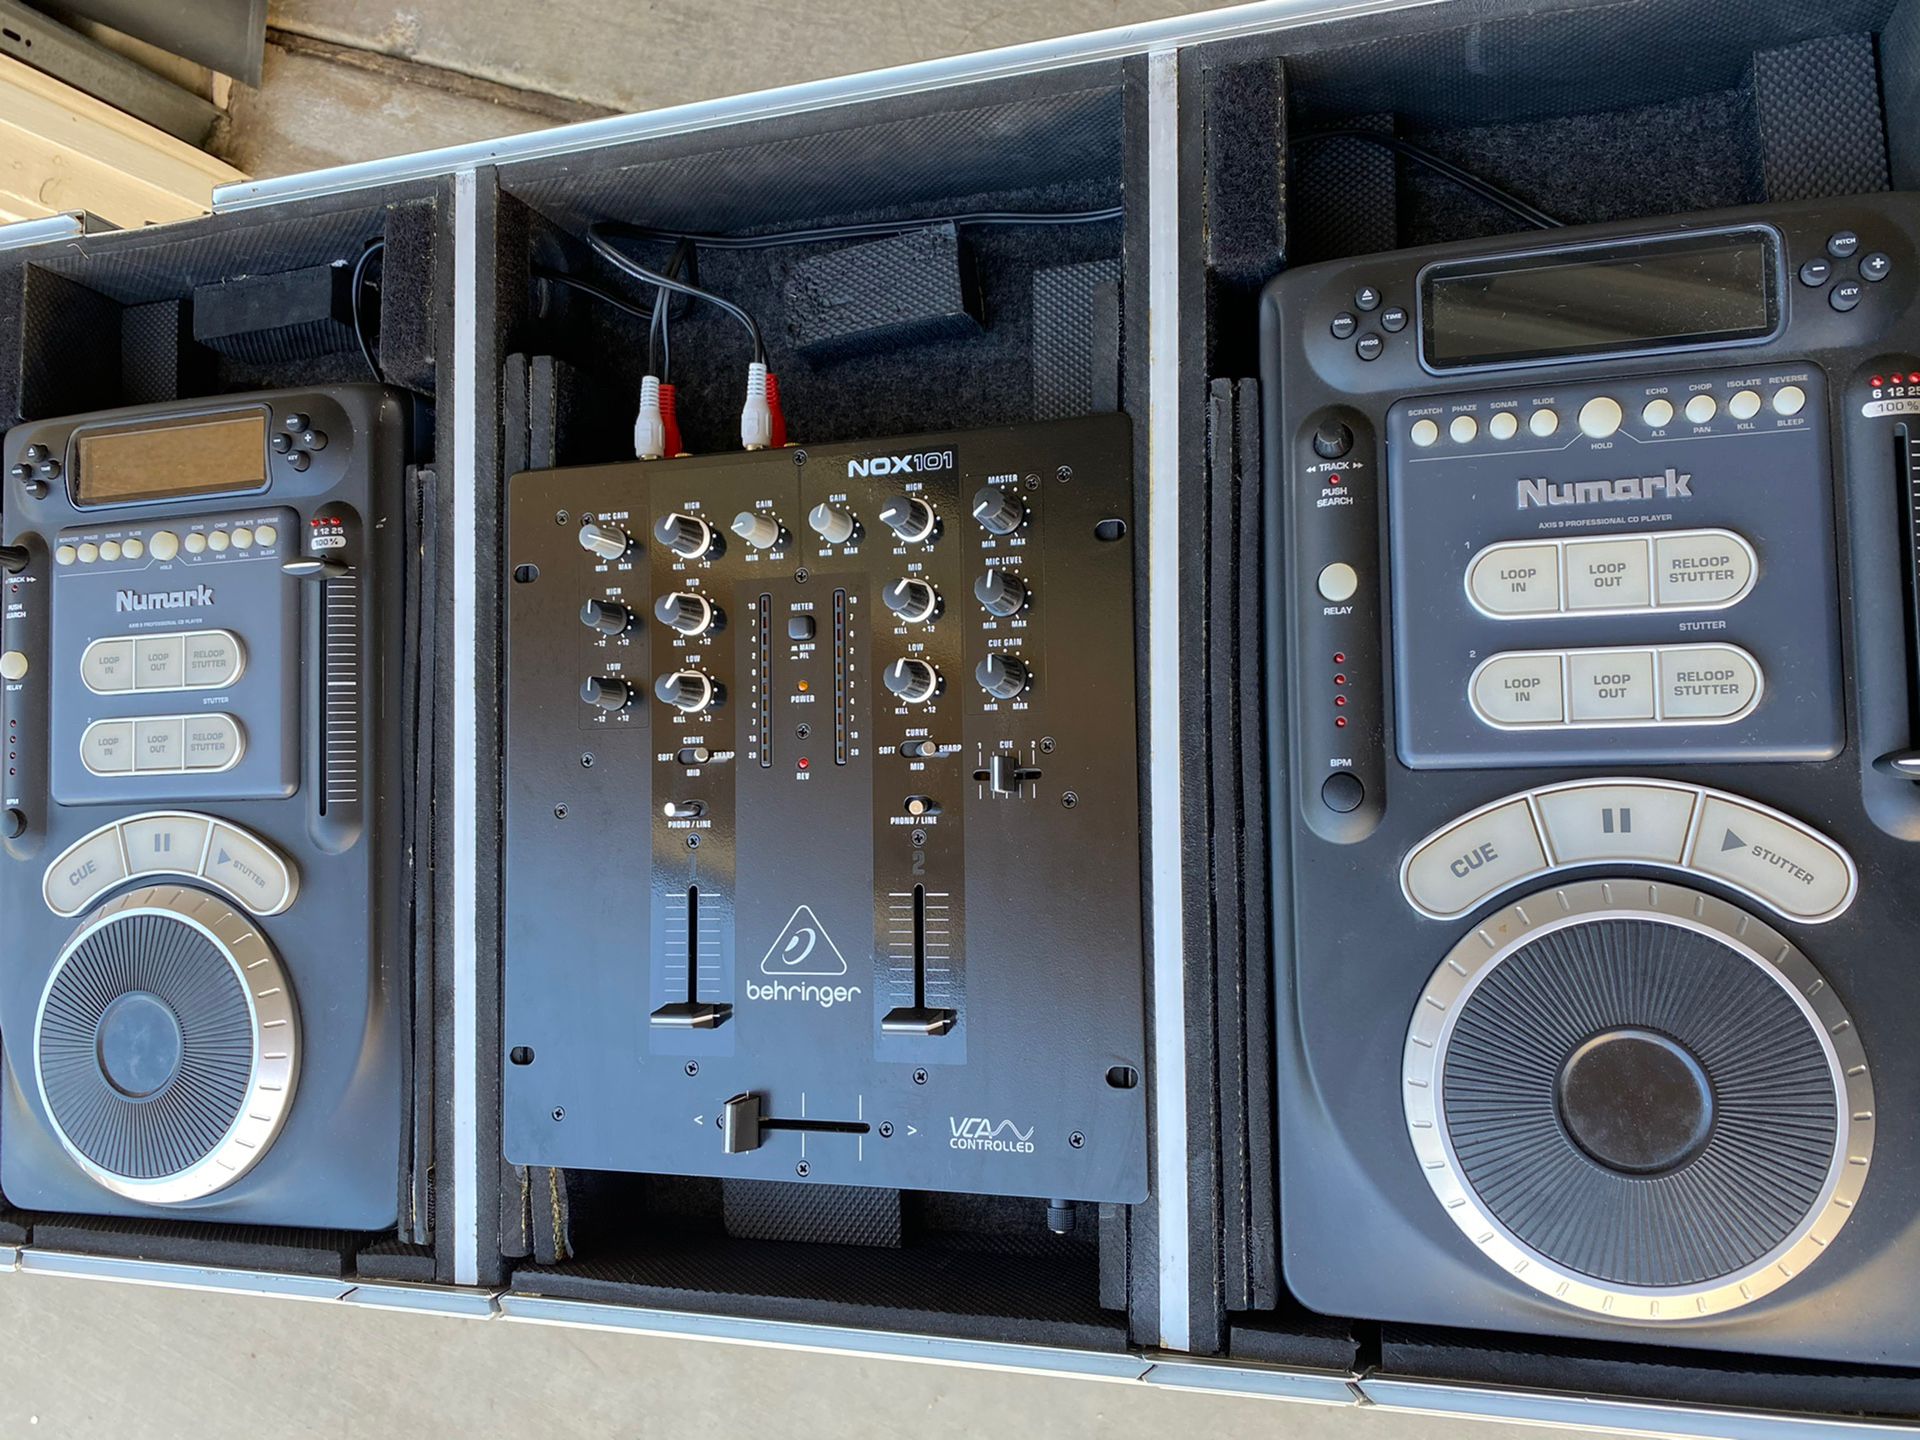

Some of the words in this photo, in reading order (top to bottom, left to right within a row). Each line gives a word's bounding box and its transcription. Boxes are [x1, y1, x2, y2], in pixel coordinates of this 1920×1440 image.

[1727, 378, 1761, 388] ISOLATE
[1769, 374, 1808, 384] REVERSE
[1646, 387, 1668, 396] ECHO
[1689, 383, 1712, 392] CHOP
[1872, 389, 1882, 399] 6
[1888, 387, 1904, 396] 12
[1490, 401, 1518, 409] SONAR
[1533, 397, 1555, 405] SLIDE
[1408, 407, 1442, 416] SCRATCH
[1452, 404, 1477, 413] PHAZE
[1777, 418, 1804, 427] BLEEP
[1591, 442, 1613, 450] HOLD
[848, 450, 952, 478] NOX101
[1319, 462, 1349, 471] TRACK
[988, 474, 1018, 484] MASTER
[905, 483, 922, 491] HIGH
[1322, 487, 1348, 496] PUSH
[1518, 468, 1692, 510] Numark
[829, 494, 846, 502] GAIN
[1317, 497, 1353, 507] SEARCH
[684, 502, 700, 510] HIGH
[756, 500, 772, 508] GAIN
[613, 512, 628, 520] GAIN
[1565, 516, 1625, 528] PROFESSIONAL
[1641, 514, 1672, 522] PLAYER
[982, 540, 996, 548] MIN
[1010, 537, 1026, 546] MAX
[844, 547, 858, 555] MAX
[893, 547, 906, 555] KILL
[985, 557, 1000, 566] MIC
[1002, 556, 1023, 564] LEVEL
[1672, 556, 1730, 569] RELOOP
[618, 563, 632, 571] MAX
[908, 563, 922, 571] MID
[1589, 563, 1626, 574] LOOP
[1500, 569, 1537, 580] LOOP
[1669, 570, 1734, 583] STUTTER
[1594, 576, 1622, 588] OUT
[1512, 582, 1526, 592] IN
[116, 584, 213, 612] Numark
[791, 602, 813, 611] METER
[1324, 606, 1353, 615] RELAY
[983, 621, 997, 629] MIN
[1011, 619, 1027, 628] MAX
[1679, 621, 1726, 631] STUTTER
[908, 643, 924, 651] LOW
[988, 639, 1002, 647] CUE
[1003, 638, 1022, 646] GAIN
[148, 653, 169, 661] LOOP
[193, 650, 225, 658] RELOOP
[192, 660, 226, 668] STUTTER
[606, 663, 621, 671] LOW
[1594, 674, 1631, 686] LOOP
[1677, 670, 1735, 682] RELOOP
[1504, 678, 1540, 689] LOOP
[1599, 688, 1627, 699] OUT
[1674, 684, 1739, 696] STUTTER
[791, 695, 815, 703] POWER
[1515, 691, 1530, 702] IN
[1013, 702, 1028, 710] MAX
[895, 707, 908, 715] KILL
[192, 733, 224, 741] RELOOP
[905, 728, 928, 737] CURVE
[682, 736, 704, 744] CURVE
[1000, 740, 1014, 749] CUE
[191, 743, 225, 751] STUTTER
[878, 746, 895, 754] SOFT
[938, 744, 962, 753] SHARP
[657, 753, 674, 761] SOFT
[713, 751, 734, 759] SHARP
[910, 762, 925, 771] MID
[1330, 758, 1352, 766] BPM
[668, 820, 690, 829] PHONO
[890, 817, 914, 825] PHONO
[912, 850, 925, 875] 2
[1450, 842, 1498, 879] CUE
[1751, 844, 1816, 886] STUTTER
[69, 861, 97, 886] CUE
[233, 860, 266, 888] STUTTER
[746, 980, 861, 1008] behringer
[949, 1117, 993, 1137] VCA
[949, 1137, 1035, 1153] CONTROLLED
